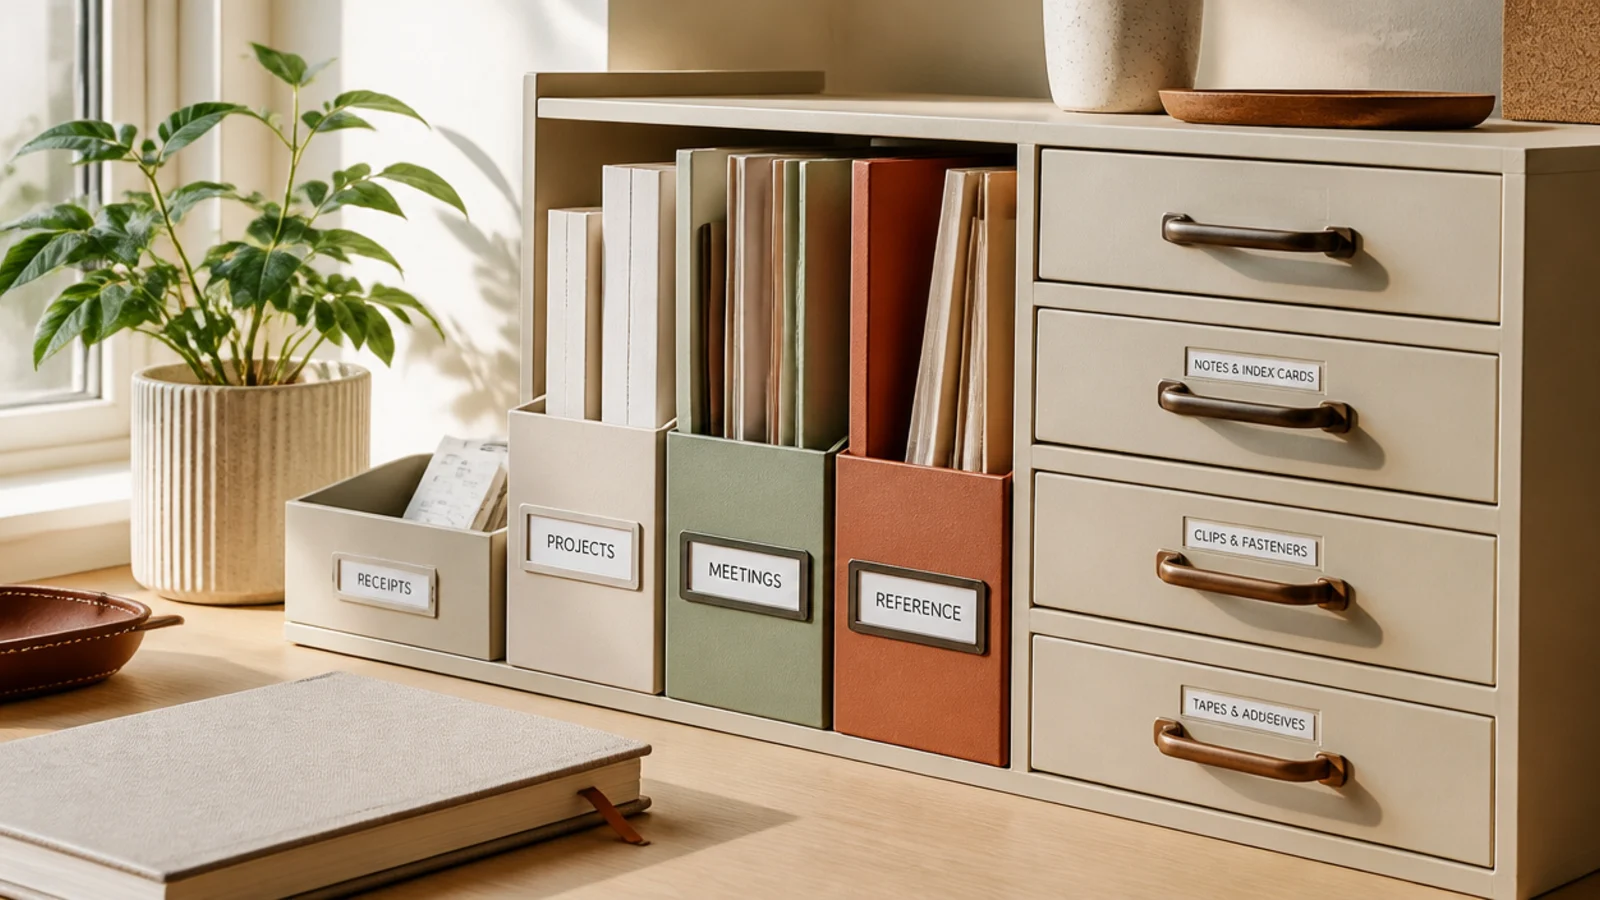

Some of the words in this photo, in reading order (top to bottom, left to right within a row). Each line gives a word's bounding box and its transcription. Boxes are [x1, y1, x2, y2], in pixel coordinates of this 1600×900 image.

[1194, 359, 1229, 373] NOTES
[1231, 363, 1239, 374] &
[1242, 365, 1275, 378] INDEX
[1277, 368, 1314, 382] CARDS
[547, 534, 615, 559] PROJECTS
[1194, 529, 1227, 545] CLIPS
[1230, 534, 1238, 547] &
[1242, 536, 1308, 557] FASTENERS
[358, 572, 412, 595] RECEIPTS
[709, 562, 782, 588] MEETINGS
[876, 591, 962, 621] REFERENCE
[1193, 698, 1227, 715] TAPES
[1231, 705, 1239, 717] &
